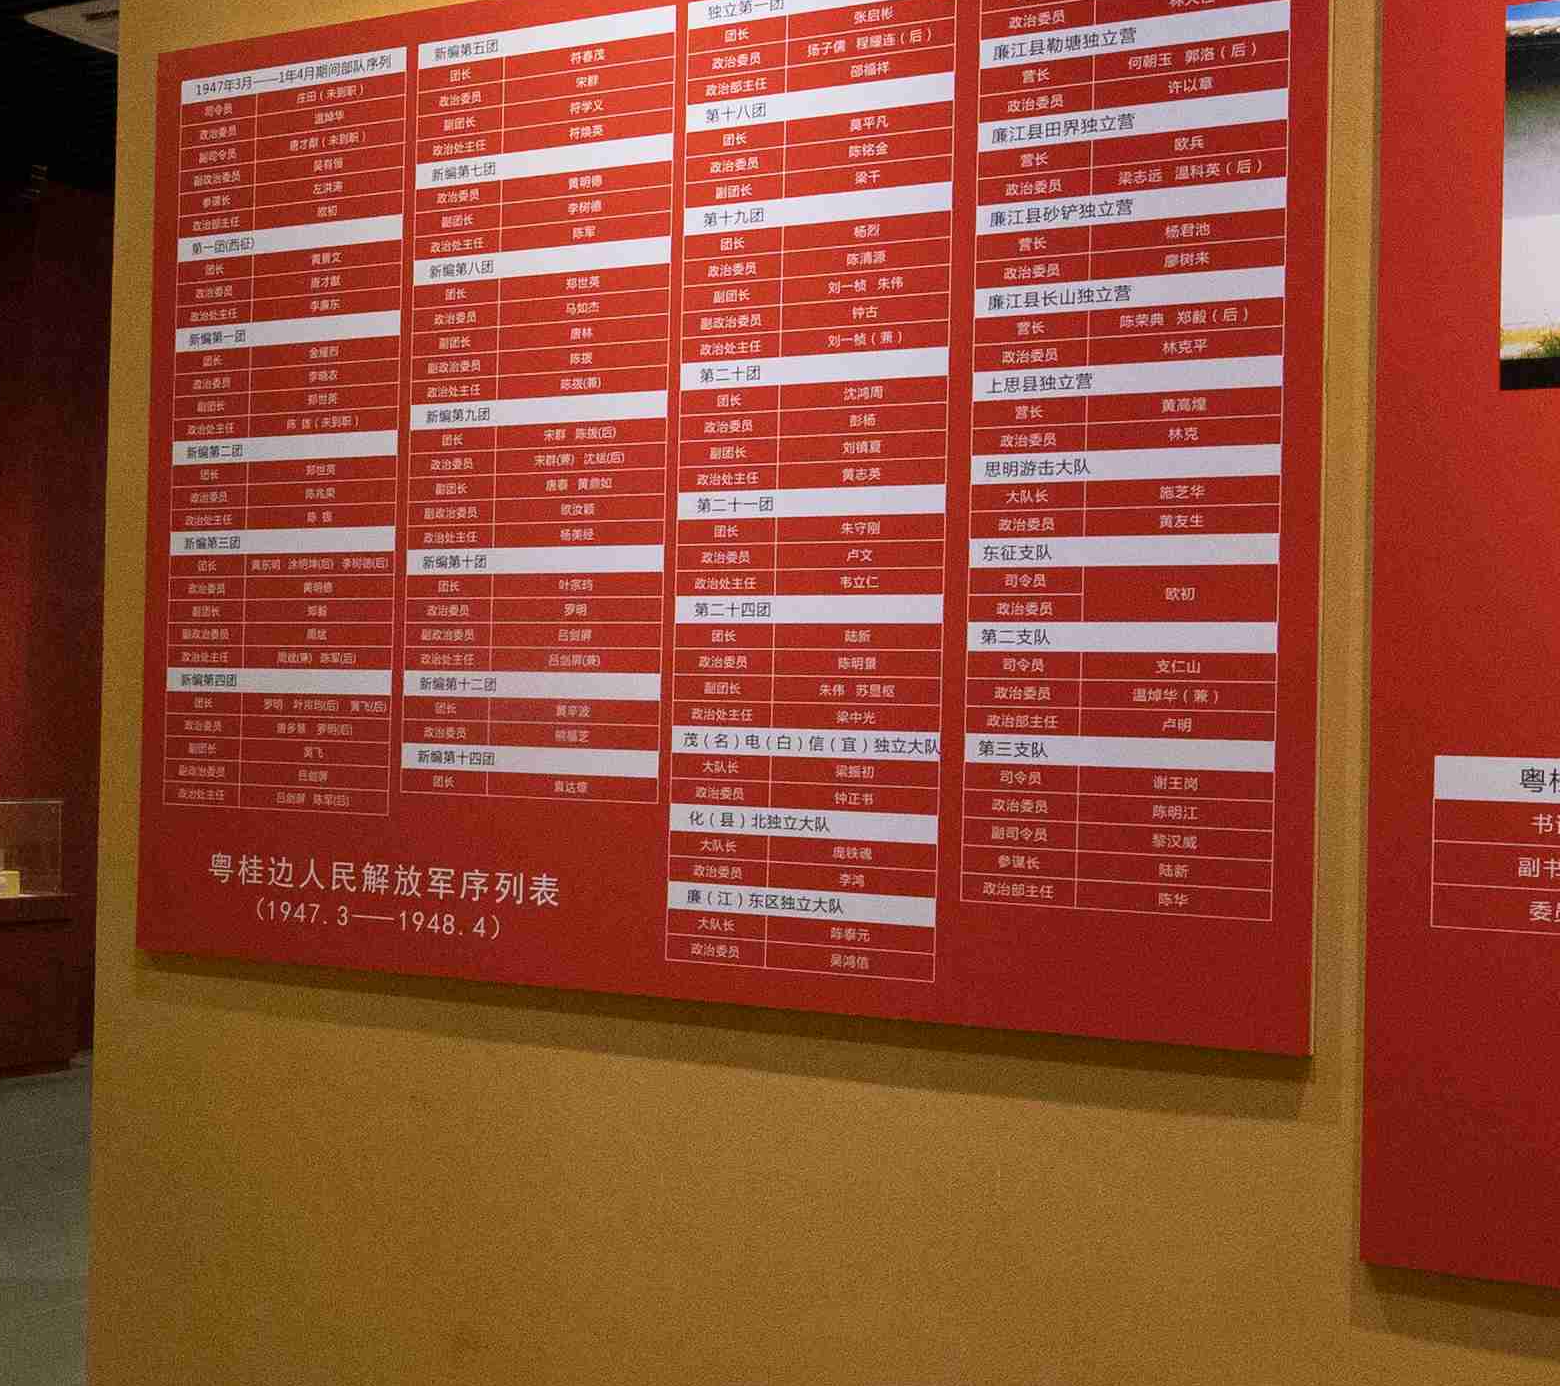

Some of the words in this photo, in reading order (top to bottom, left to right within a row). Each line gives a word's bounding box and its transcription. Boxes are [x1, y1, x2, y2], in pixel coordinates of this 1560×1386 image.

[704, 208, 764, 229] 第十九团
[699, 365, 761, 383] 第二十团
[984, 458, 1090, 478] 思明游击大队
[697, 496, 773, 514] 第二十一团
[982, 544, 1052, 562] 东征支队
[694, 602, 771, 617] 第二十四团
[981, 629, 1050, 646] 第二支队
[978, 740, 1048, 758] 第三支队
[208, 852, 560, 907] 粤桂边人民解放军序列表
